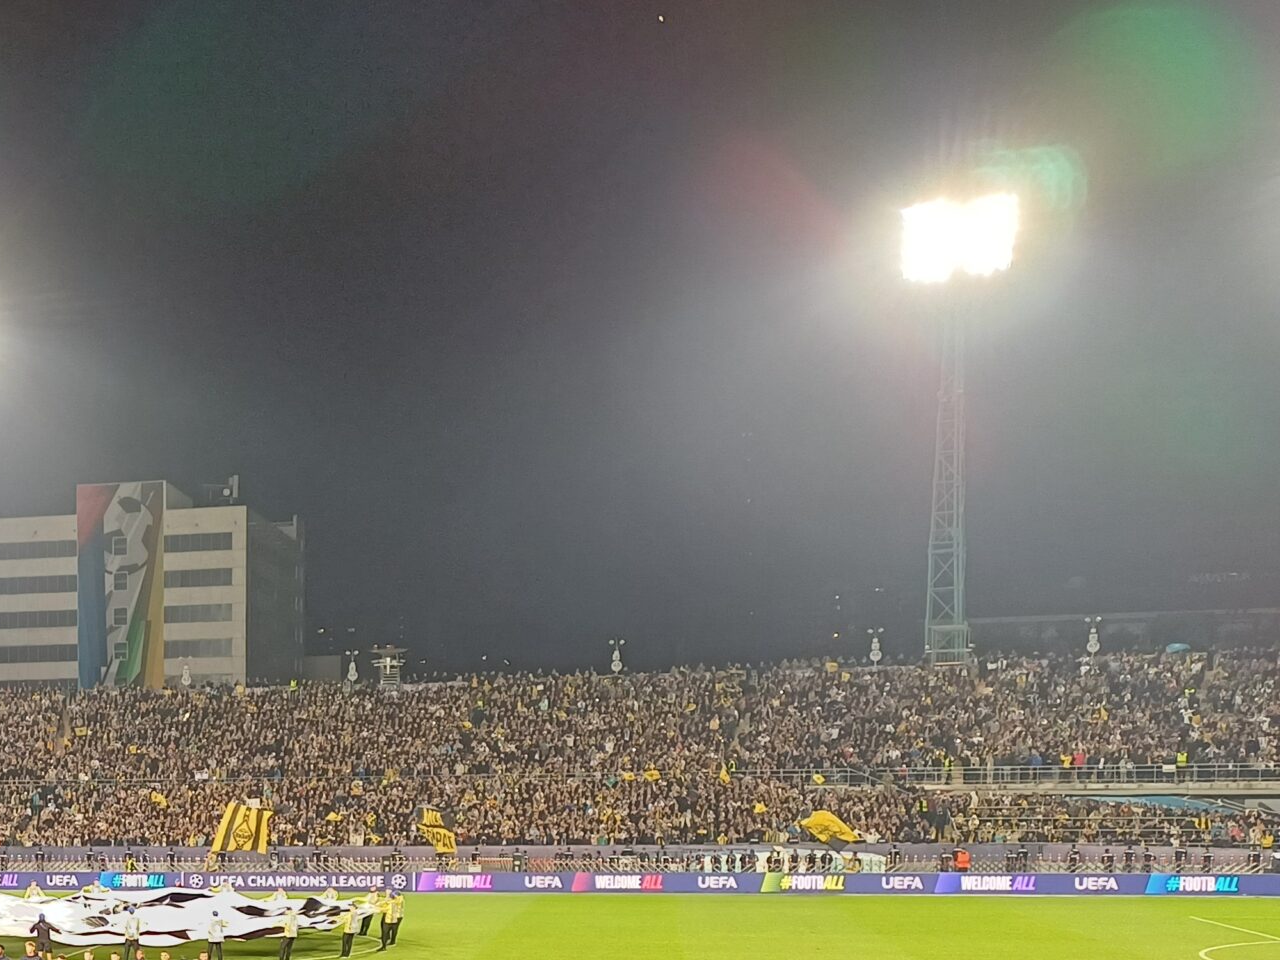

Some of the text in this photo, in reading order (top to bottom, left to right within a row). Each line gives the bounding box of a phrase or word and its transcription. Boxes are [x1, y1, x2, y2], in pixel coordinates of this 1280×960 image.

[46, 873, 78, 887] UEFA
[210, 874, 385, 888] UEFA CHAMPIONS LEAGUE
[525, 876, 563, 889] UEFA
[697, 876, 737, 889] UEFA
[882, 876, 923, 890] UEFA
[1074, 876, 1118, 891] UEFA
